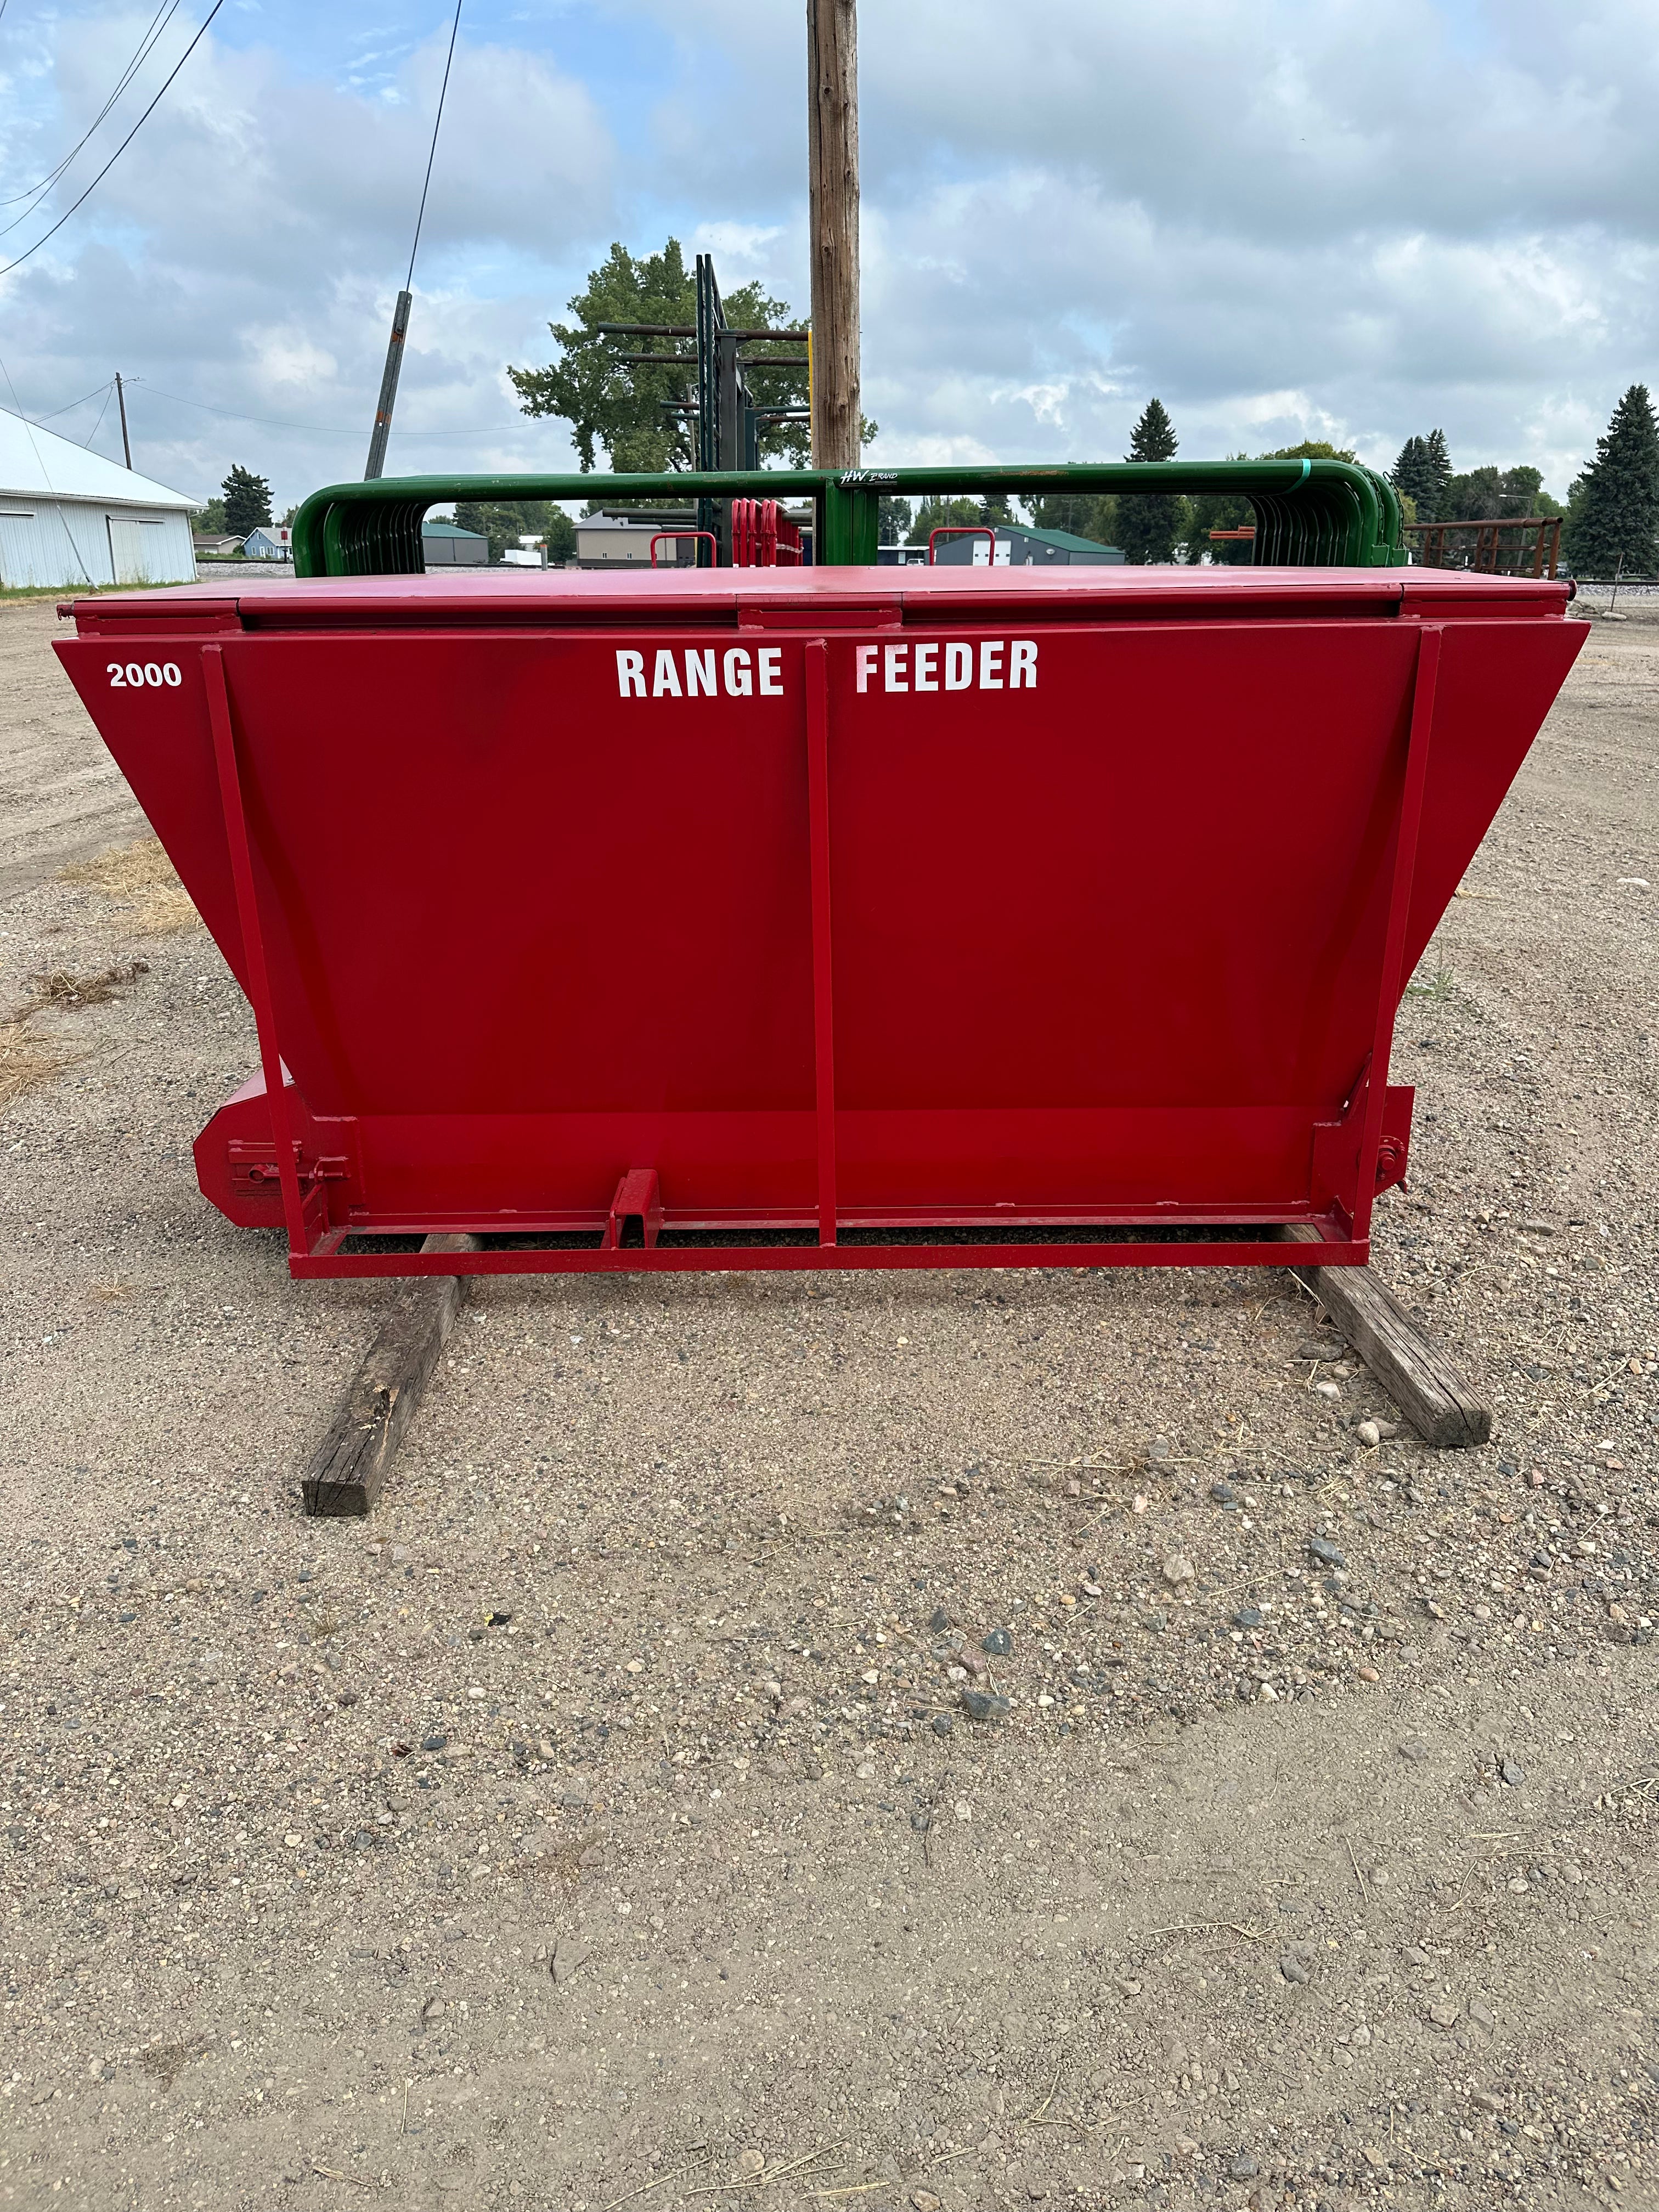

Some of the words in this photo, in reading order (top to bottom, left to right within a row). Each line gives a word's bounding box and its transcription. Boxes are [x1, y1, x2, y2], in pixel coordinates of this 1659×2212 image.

[869, 473, 898, 482] BRAND
[107, 663, 182, 687] 2000
[616, 647, 784, 698] RANGE
[856, 640, 1038, 693] FEEDER
